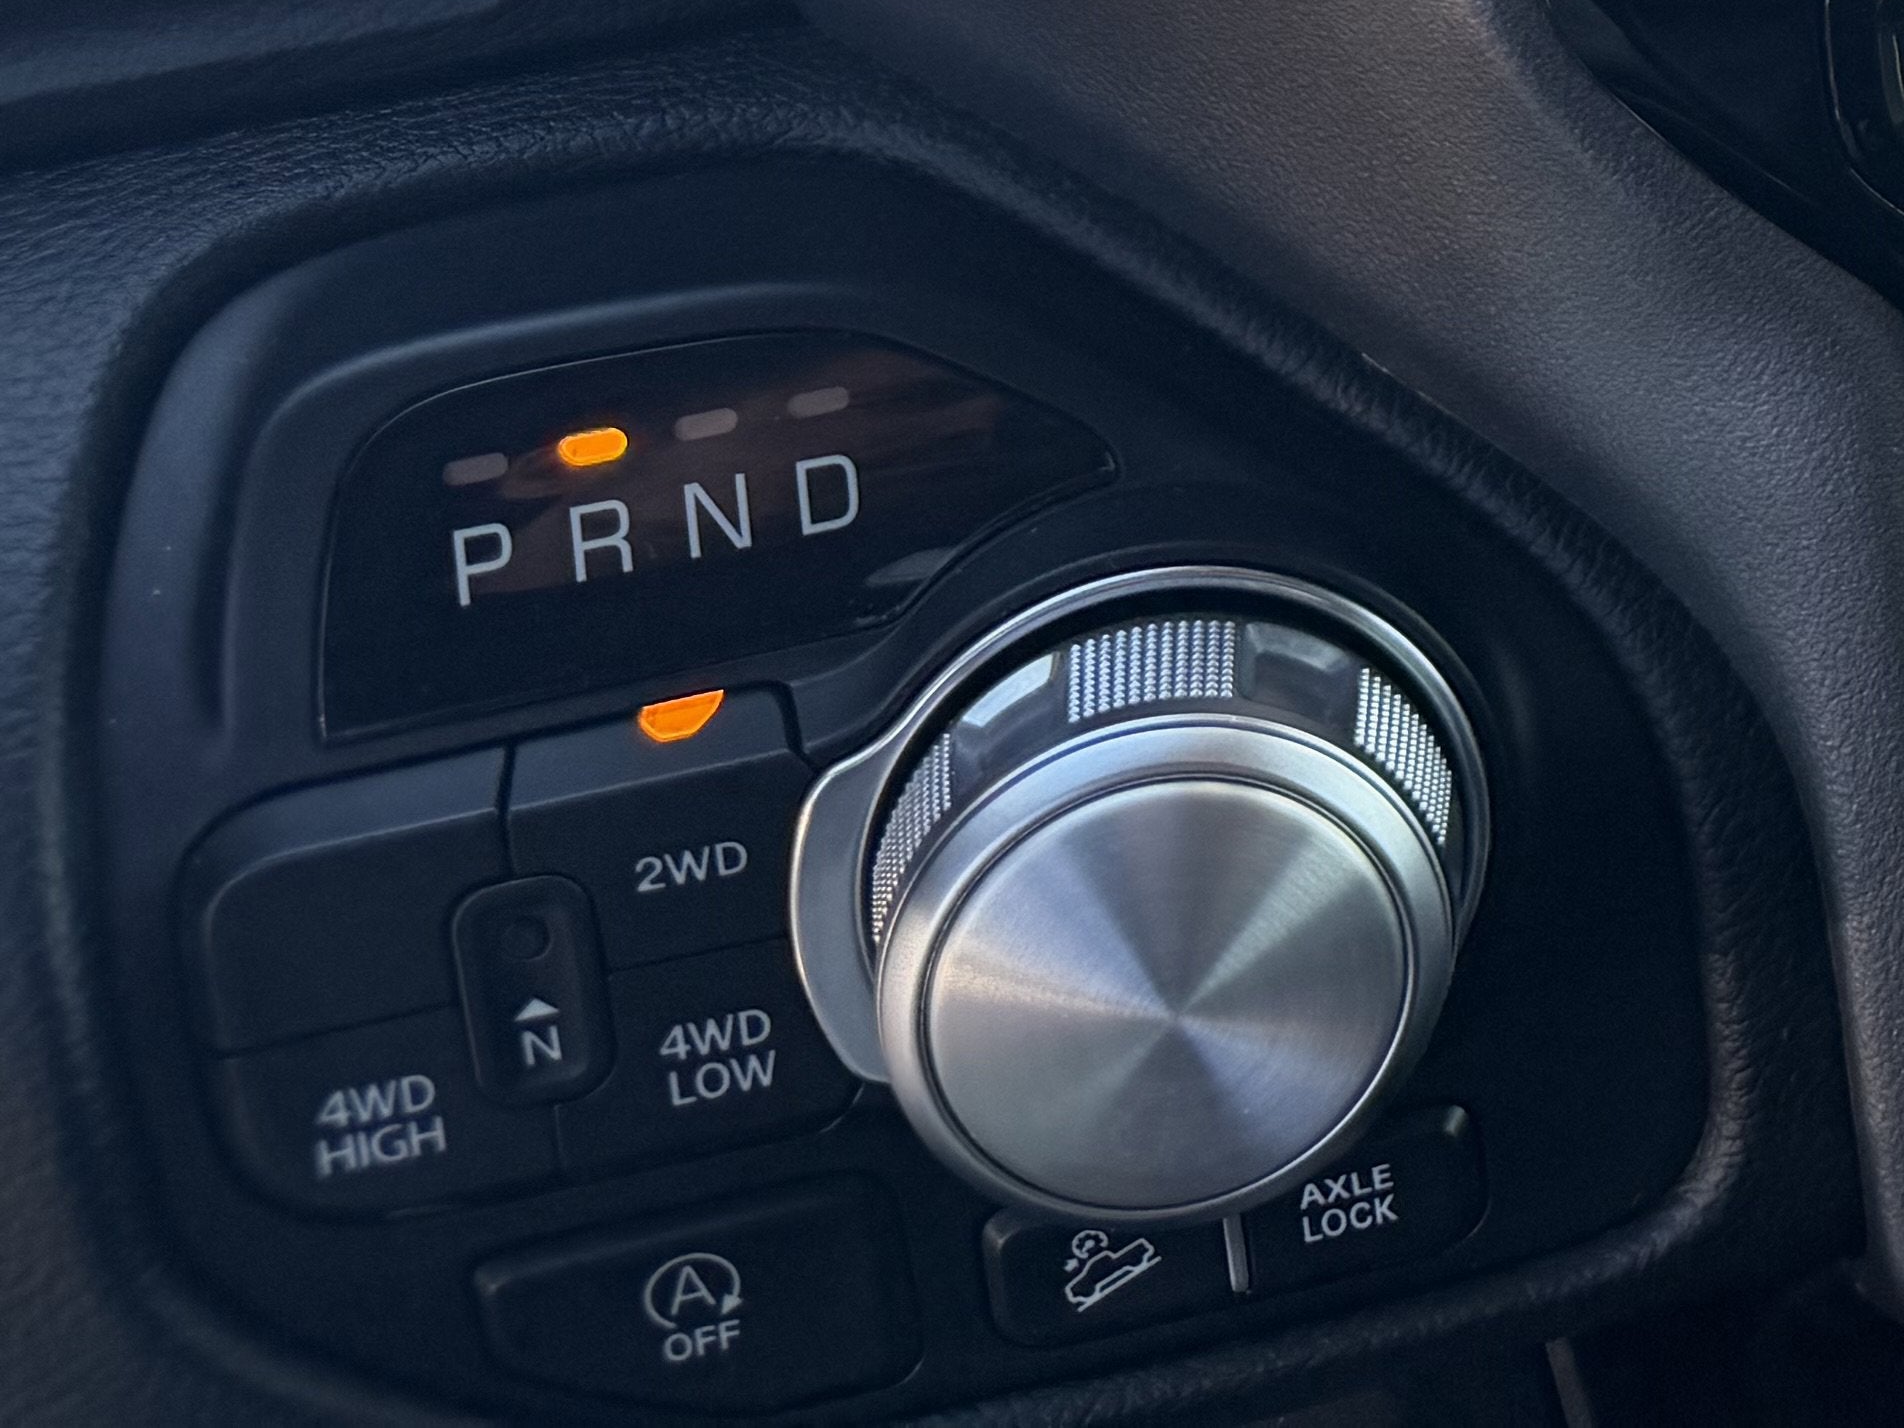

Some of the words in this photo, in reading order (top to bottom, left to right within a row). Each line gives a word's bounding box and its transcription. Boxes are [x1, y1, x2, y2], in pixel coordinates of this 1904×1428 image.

[453, 522, 513, 607] P
[569, 499, 634, 583] R
[683, 473, 753, 559] N
[795, 454, 860, 536] D
[634, 841, 748, 892] 2WD
[520, 1025, 562, 1066] N
[659, 1009, 771, 1061] 4WD
[316, 1074, 436, 1128] 4WD
[669, 1049, 776, 1106] LOW
[316, 1115, 447, 1178] HIGH
[1301, 1164, 1394, 1210] AXLE
[1302, 1194, 1398, 1243] LOCK
[664, 1319, 740, 1361] OFF
